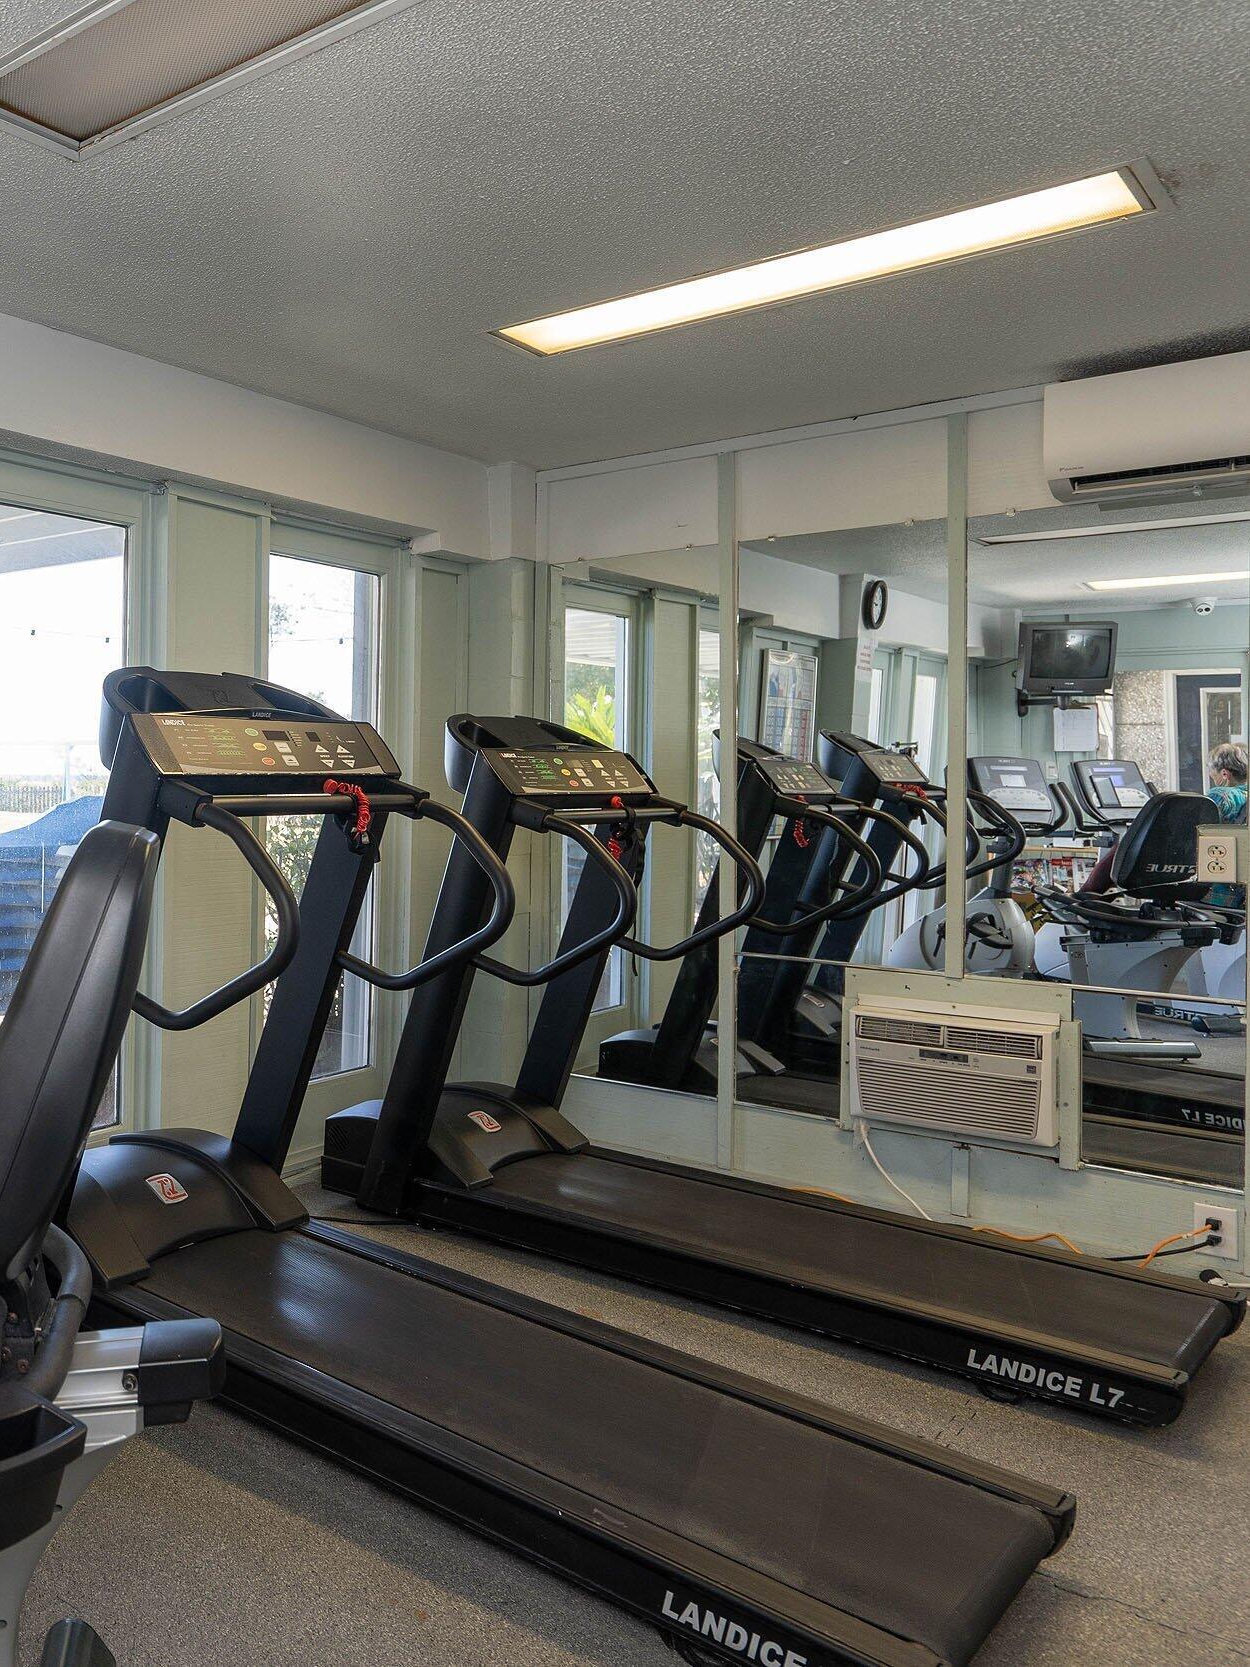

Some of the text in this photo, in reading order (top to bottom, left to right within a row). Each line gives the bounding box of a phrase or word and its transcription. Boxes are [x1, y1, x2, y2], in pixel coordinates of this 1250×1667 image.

[967, 1349, 1125, 1408] LANDICE L7
[661, 1590, 808, 1667] LANDICE
